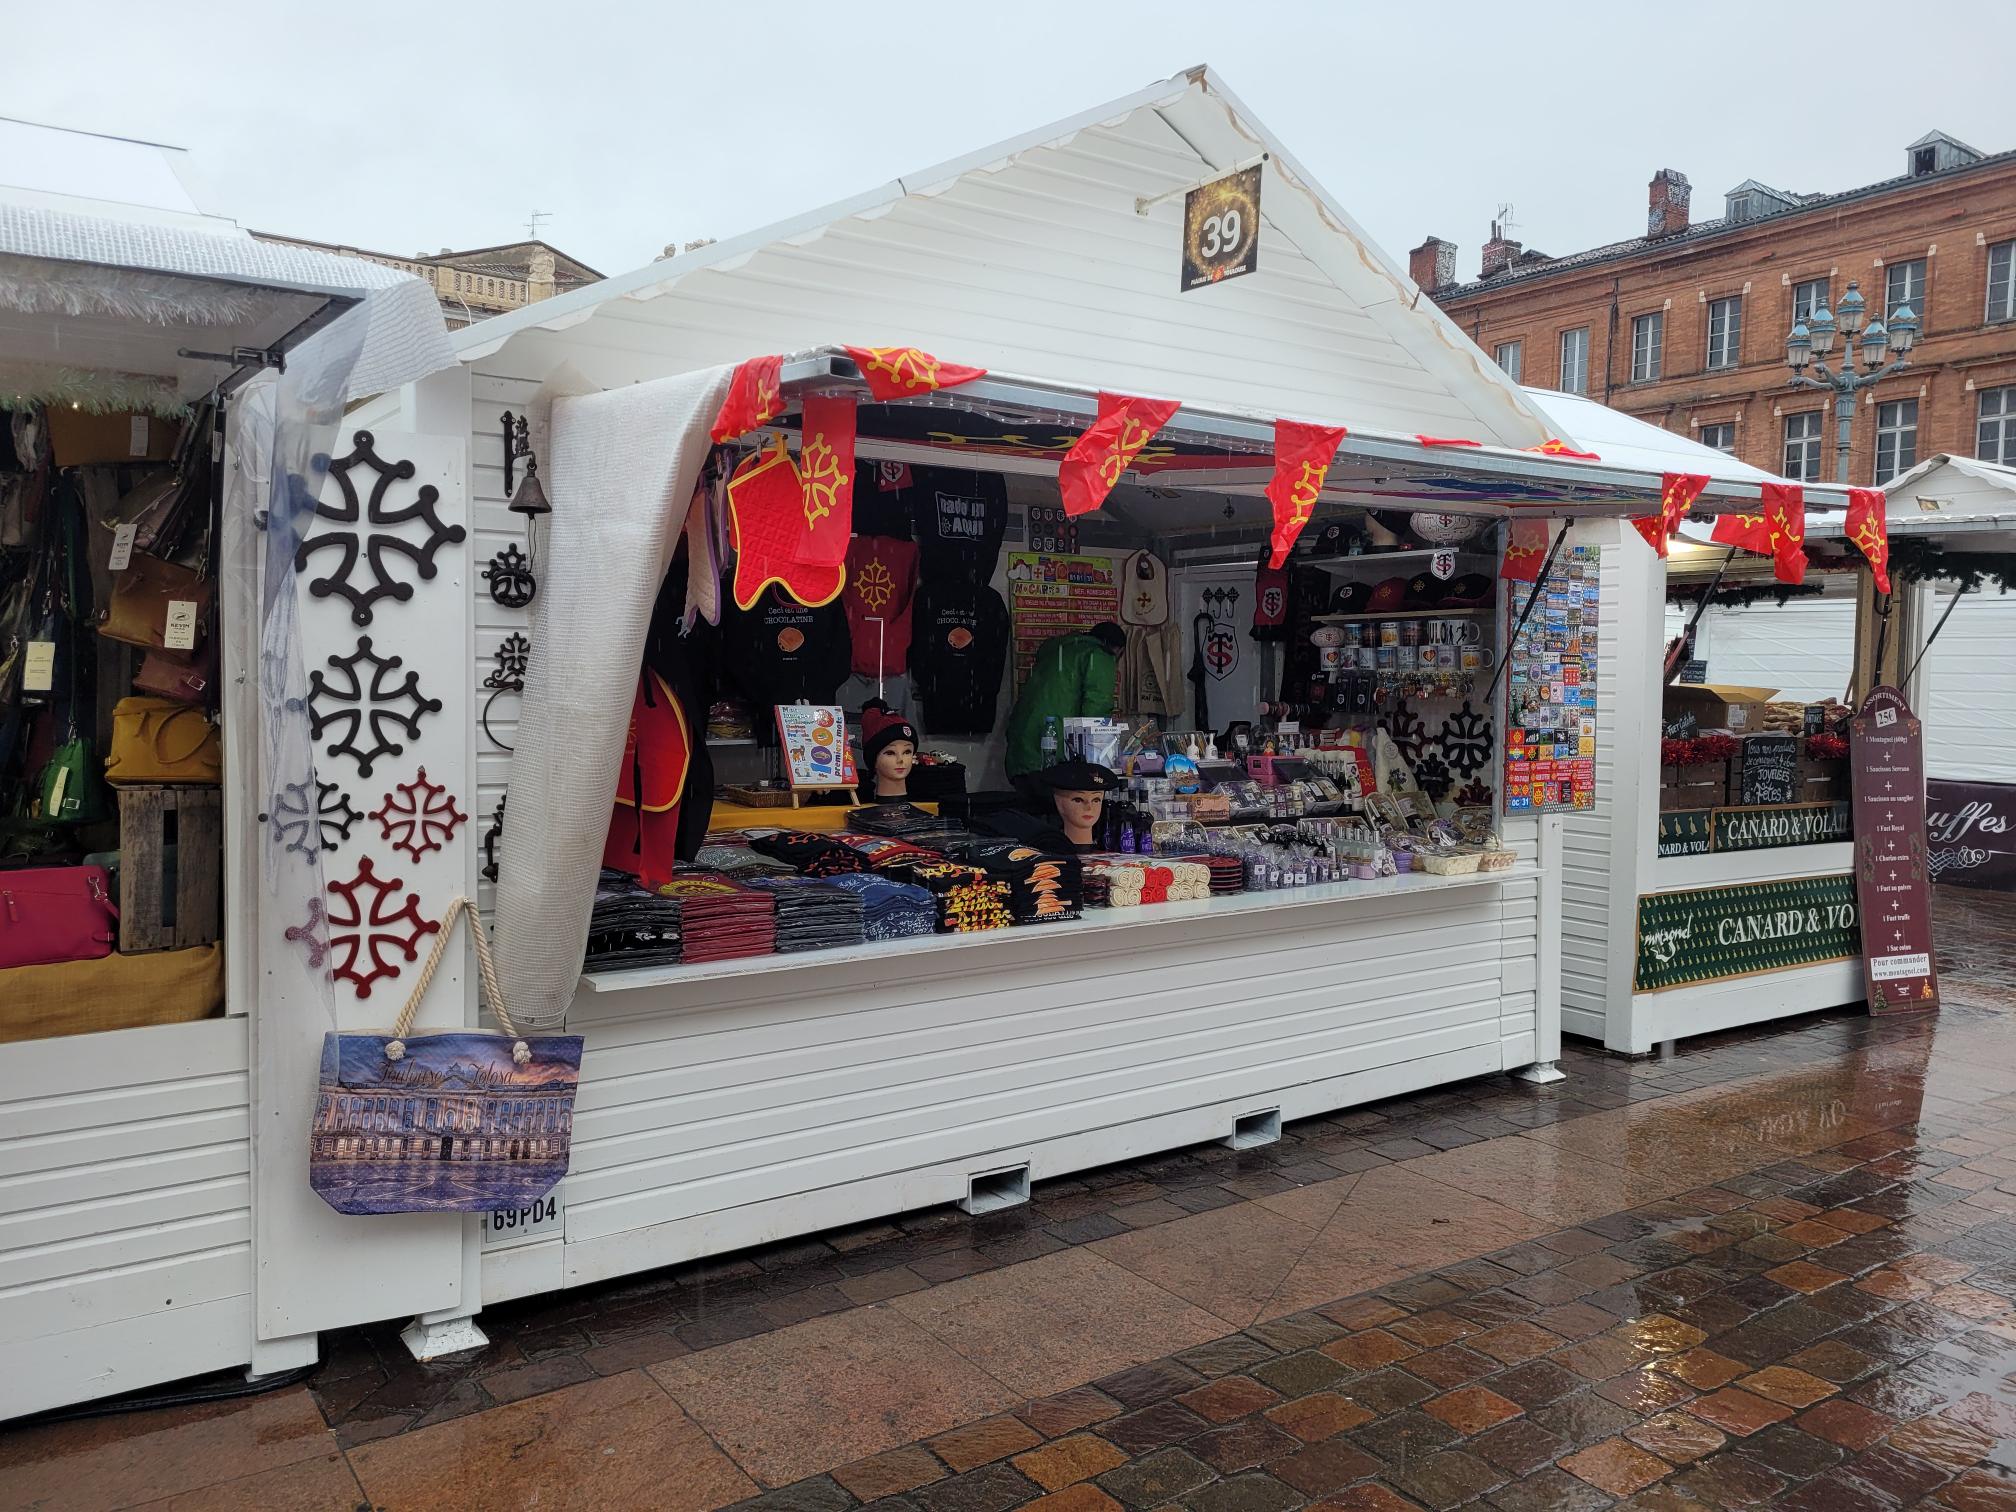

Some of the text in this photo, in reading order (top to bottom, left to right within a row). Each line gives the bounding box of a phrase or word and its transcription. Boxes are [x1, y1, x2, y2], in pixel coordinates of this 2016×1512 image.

[1201, 209, 1241, 258] 39
[952, 517, 984, 536] AQUI
[1863, 692, 1907, 712] ASSORTIMENT
[1878, 709, 1895, 725] 25€
[834, 739, 842, 777] premiers
[1757, 768, 1790, 784] JOYEUSES
[1511, 797, 1529, 806] OC 31
[1728, 816, 1789, 840] CANARD
[1791, 816, 1801, 836] &
[1682, 842, 1689, 853] &
[1718, 909, 1803, 946] CANARD
[1806, 907, 1821, 934] &
[1886, 914, 1897, 922] Fuet
[1872, 954, 1928, 968] Pour commander
[1873, 966, 1928, 978] www.montagnel.com
[377, 1056, 513, 1086] Toulouse Tolosa
